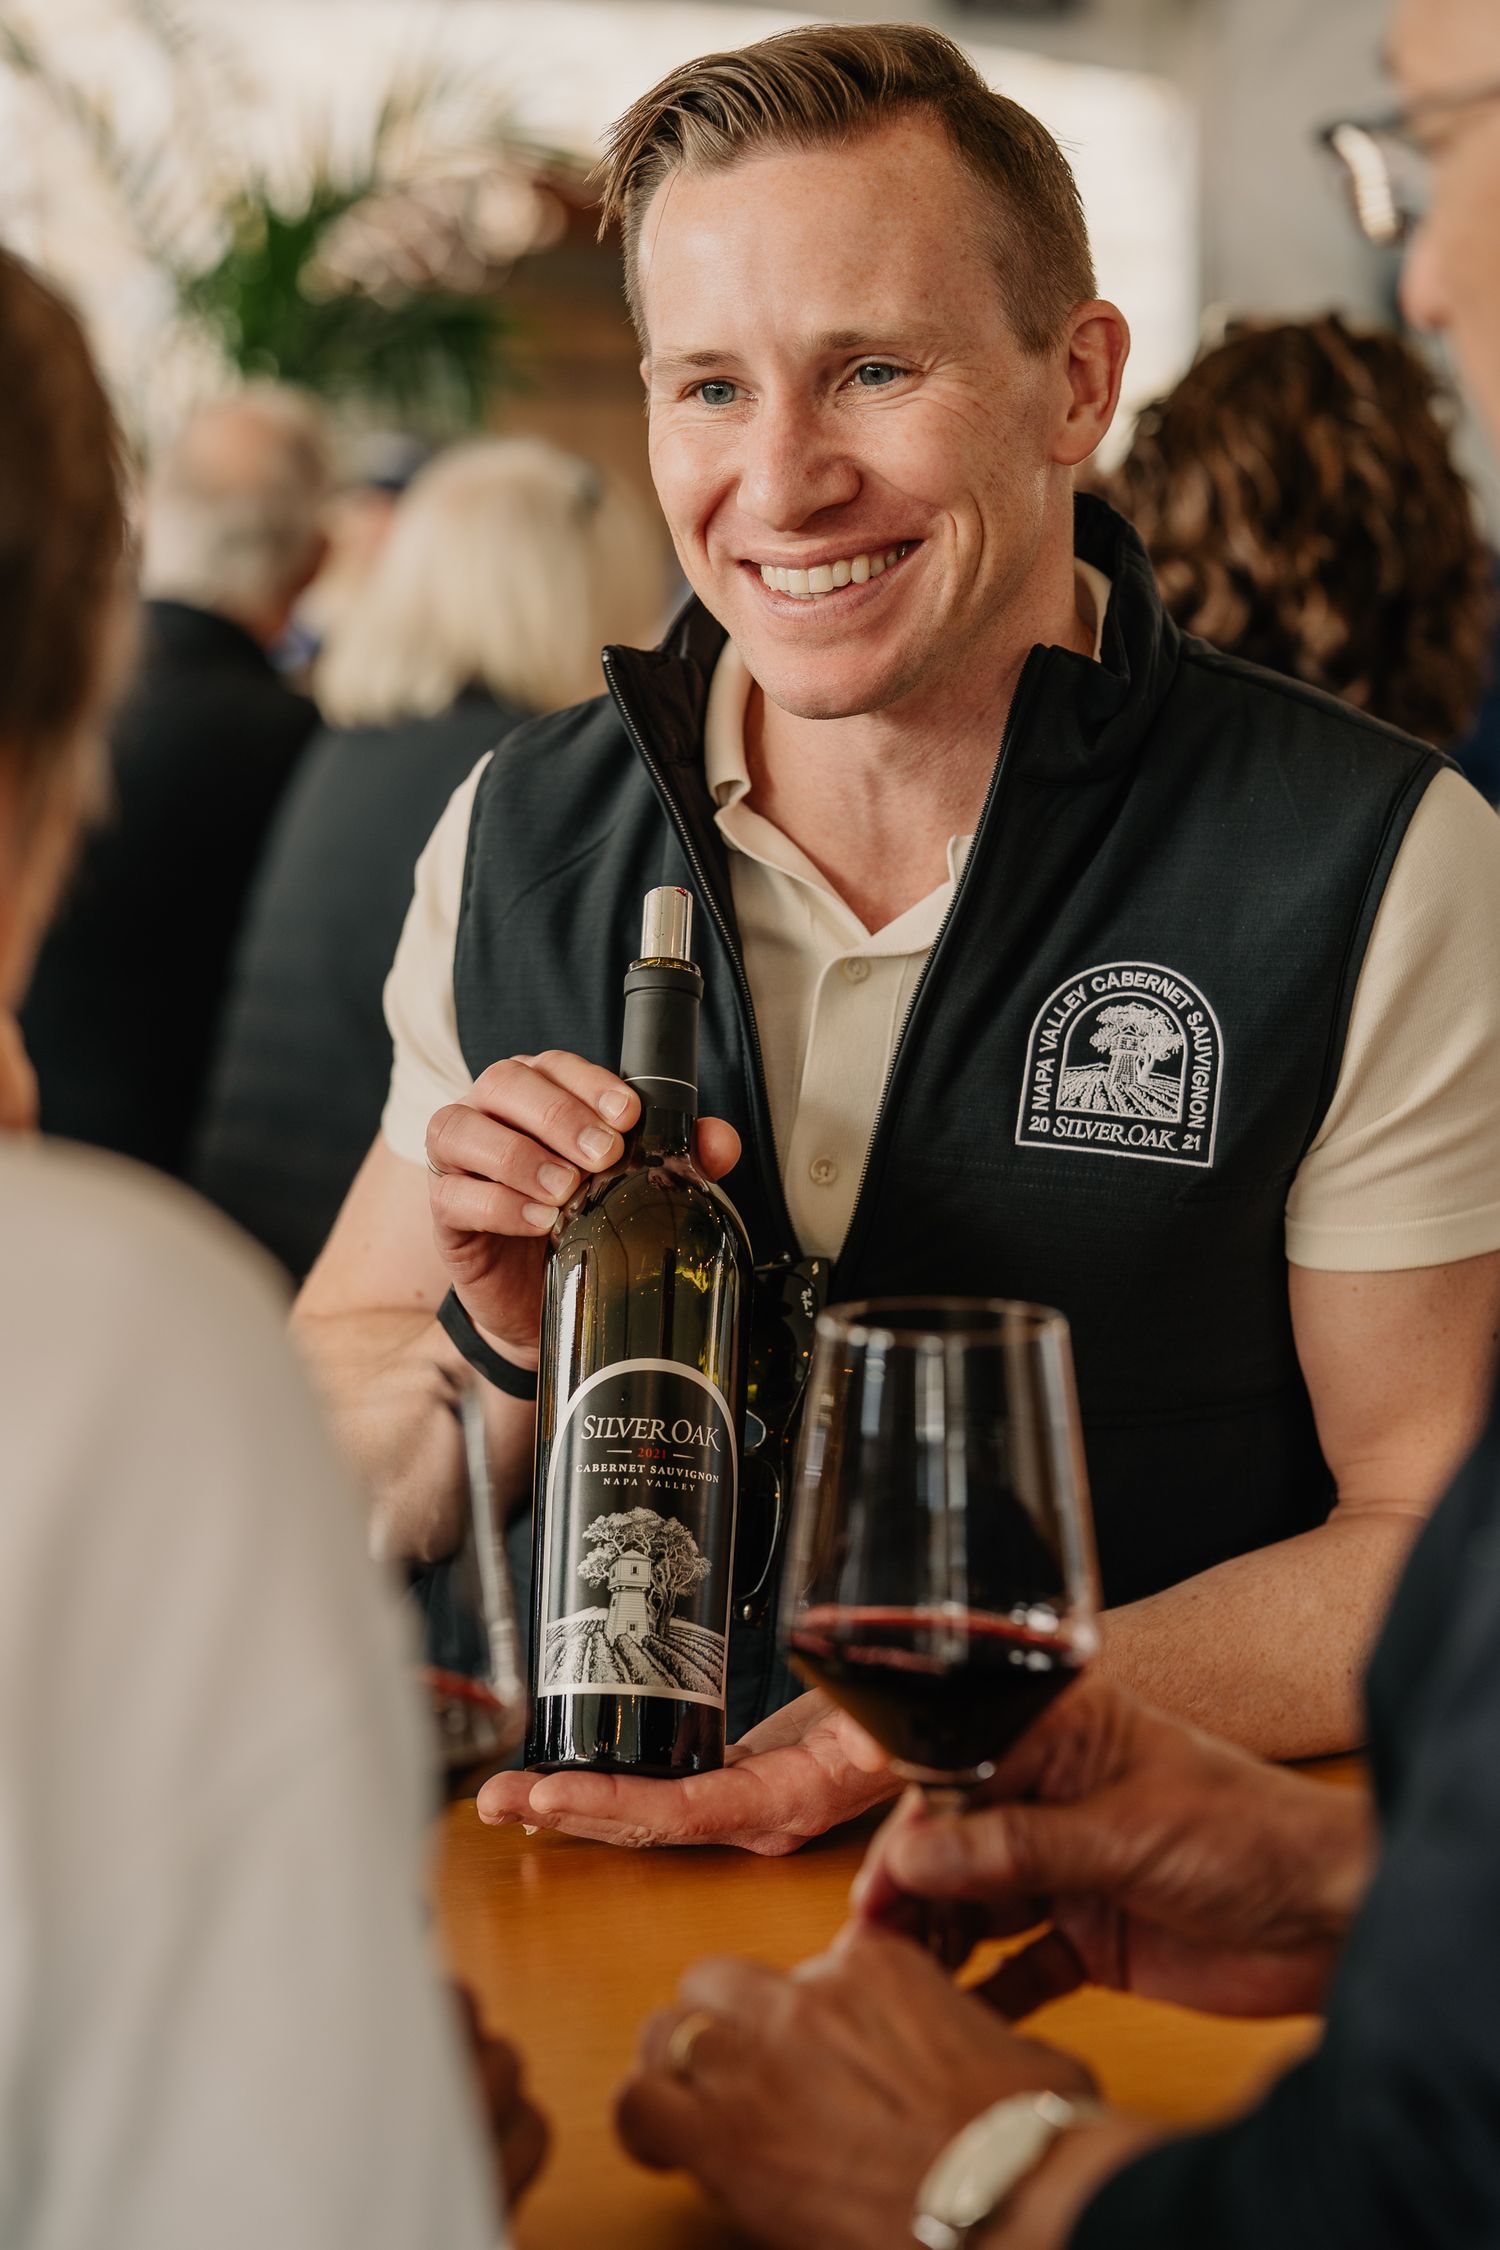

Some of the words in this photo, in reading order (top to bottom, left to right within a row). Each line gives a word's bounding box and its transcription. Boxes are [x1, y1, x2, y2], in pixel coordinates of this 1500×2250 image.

[1091, 971, 1193, 1010] CABERNET
[1038, 983, 1088, 1053] VALLEY
[1031, 1057, 1056, 1111] NAPA
[1186, 1011, 1212, 1129] SAUVIGNON
[1028, 1116, 1050, 1133] 20
[1052, 1115, 1130, 1146] SILVER
[1127, 1123, 1178, 1152] OAK
[1181, 1133, 1201, 1151] 21
[581, 1414, 671, 1444] SILVER
[671, 1419, 721, 1452] OAK
[637, 1447, 666, 1460] 2021
[575, 1463, 645, 1473] CABERNET
[650, 1465, 719, 1483] SAUVIGNON
[603, 1477, 638, 1486] NAPA
[646, 1479, 695, 1492] VALLEY
